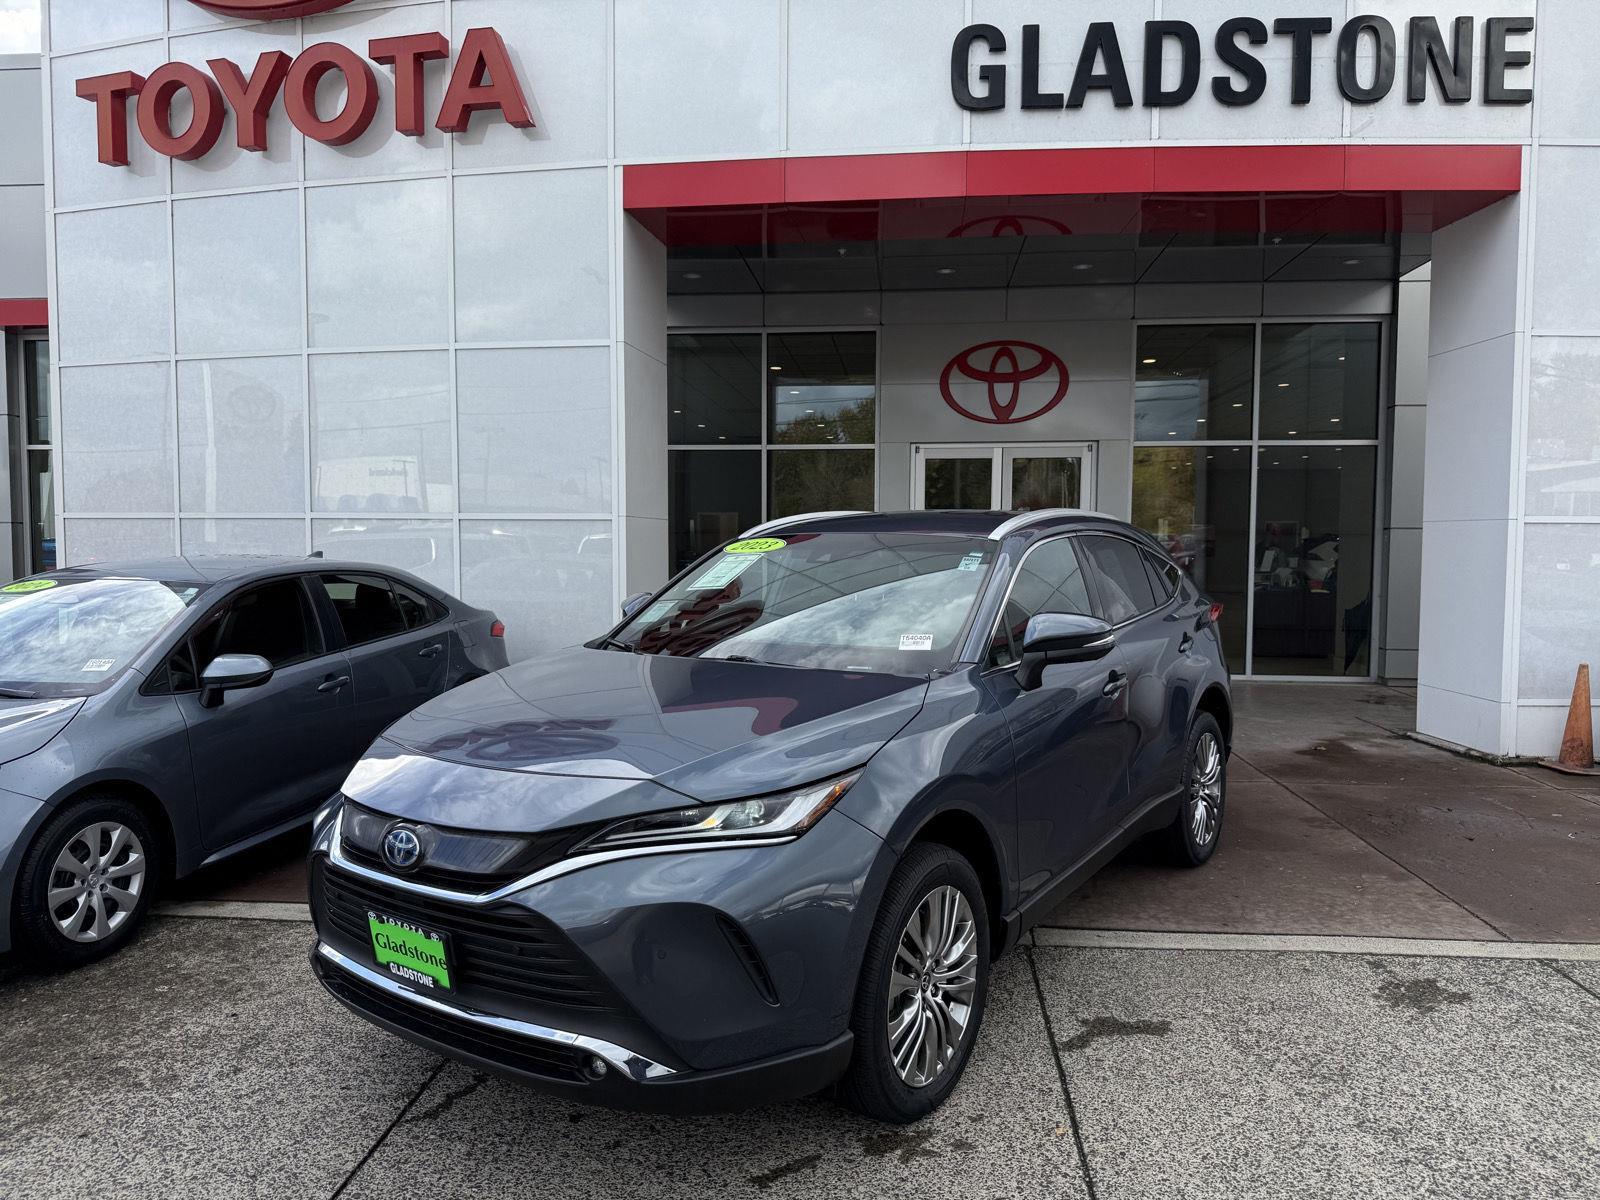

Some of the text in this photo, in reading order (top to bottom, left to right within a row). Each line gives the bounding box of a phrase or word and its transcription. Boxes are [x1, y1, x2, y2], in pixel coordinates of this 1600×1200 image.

[950, 15, 1534, 111] GLADSTONE
[75, 27, 536, 167] TOYOTA
[729, 541, 780, 551] 2023
[382, 915, 424, 936] TOYOTA
[374, 932, 448, 971] Gladstone
[389, 962, 434, 988] GLADSTONE
